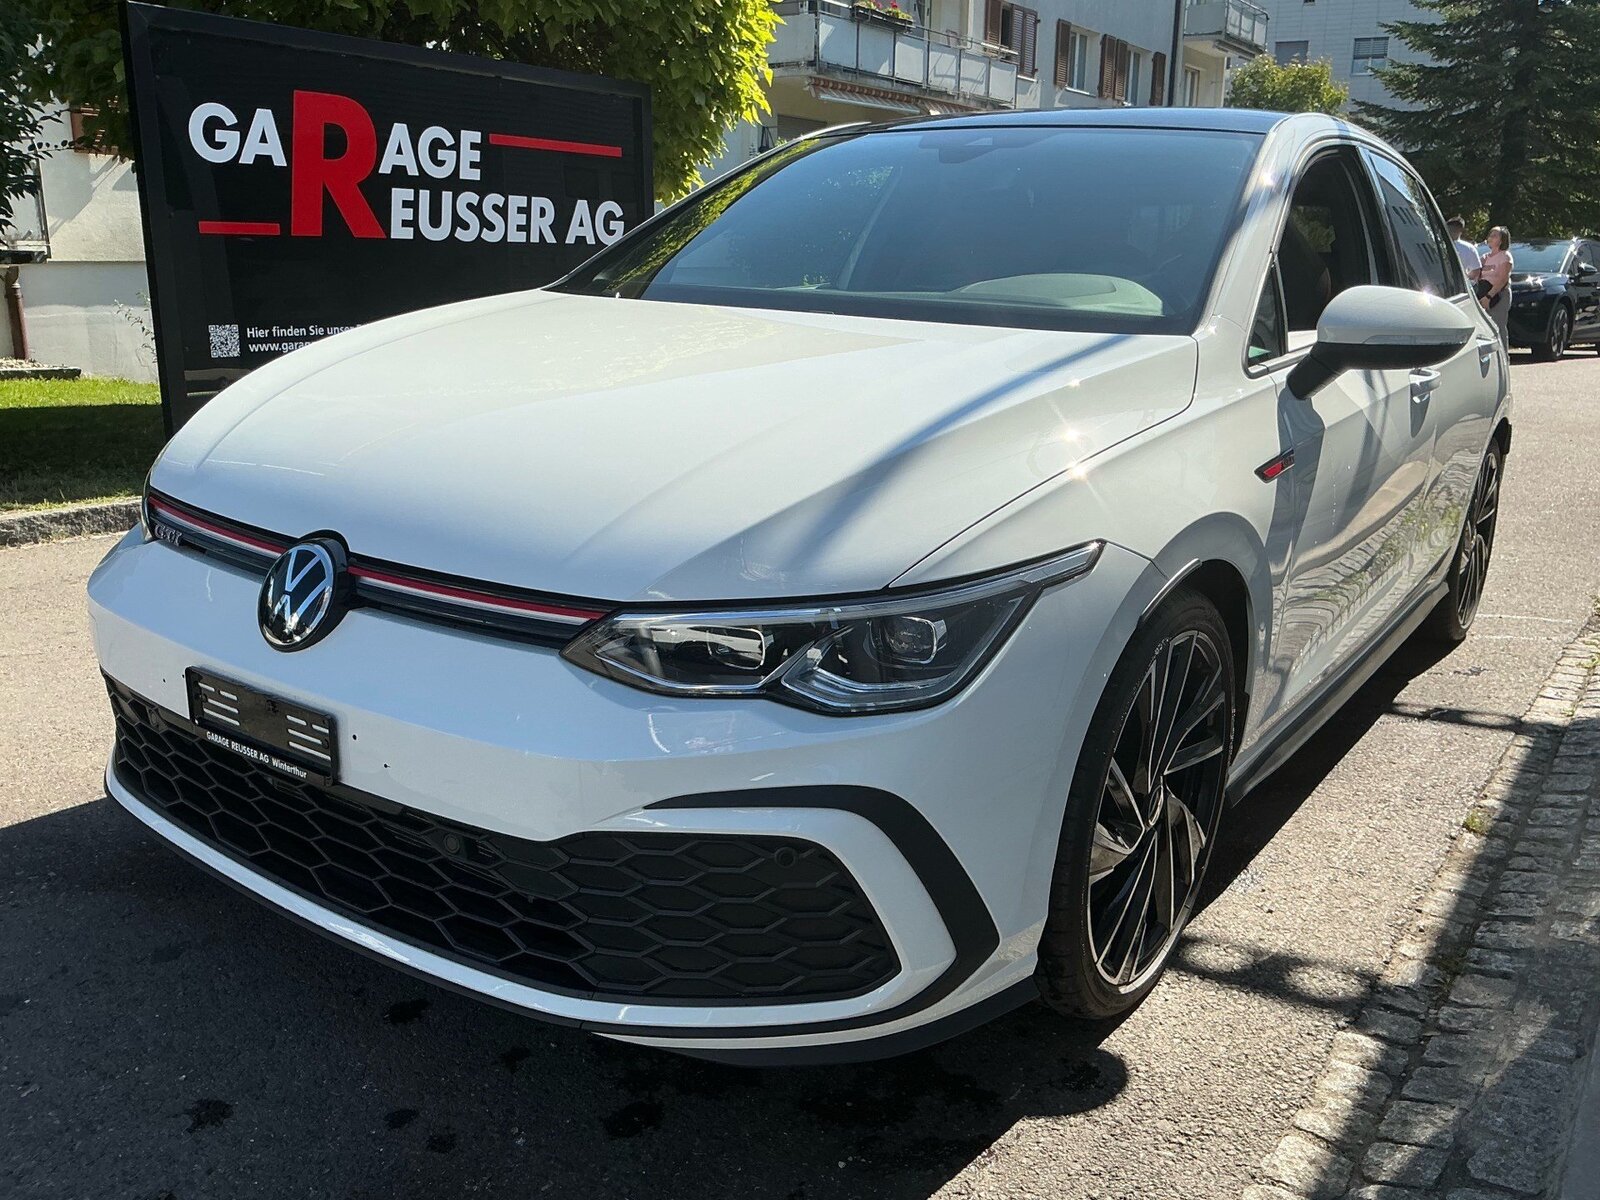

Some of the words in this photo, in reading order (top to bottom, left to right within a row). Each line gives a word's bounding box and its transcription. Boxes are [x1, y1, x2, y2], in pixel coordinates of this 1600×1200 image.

[188, 90, 482, 238] GARAGE
[565, 199, 625, 246] AG
[247, 326, 270, 338] Hier
[271, 325, 307, 337] finden
[308, 325, 325, 336] Sie
[206, 730, 230, 748] GARAGE
[231, 741, 259, 760] REUSSER
[259, 753, 269, 764] AG
[271, 757, 308, 779] Winterthur
